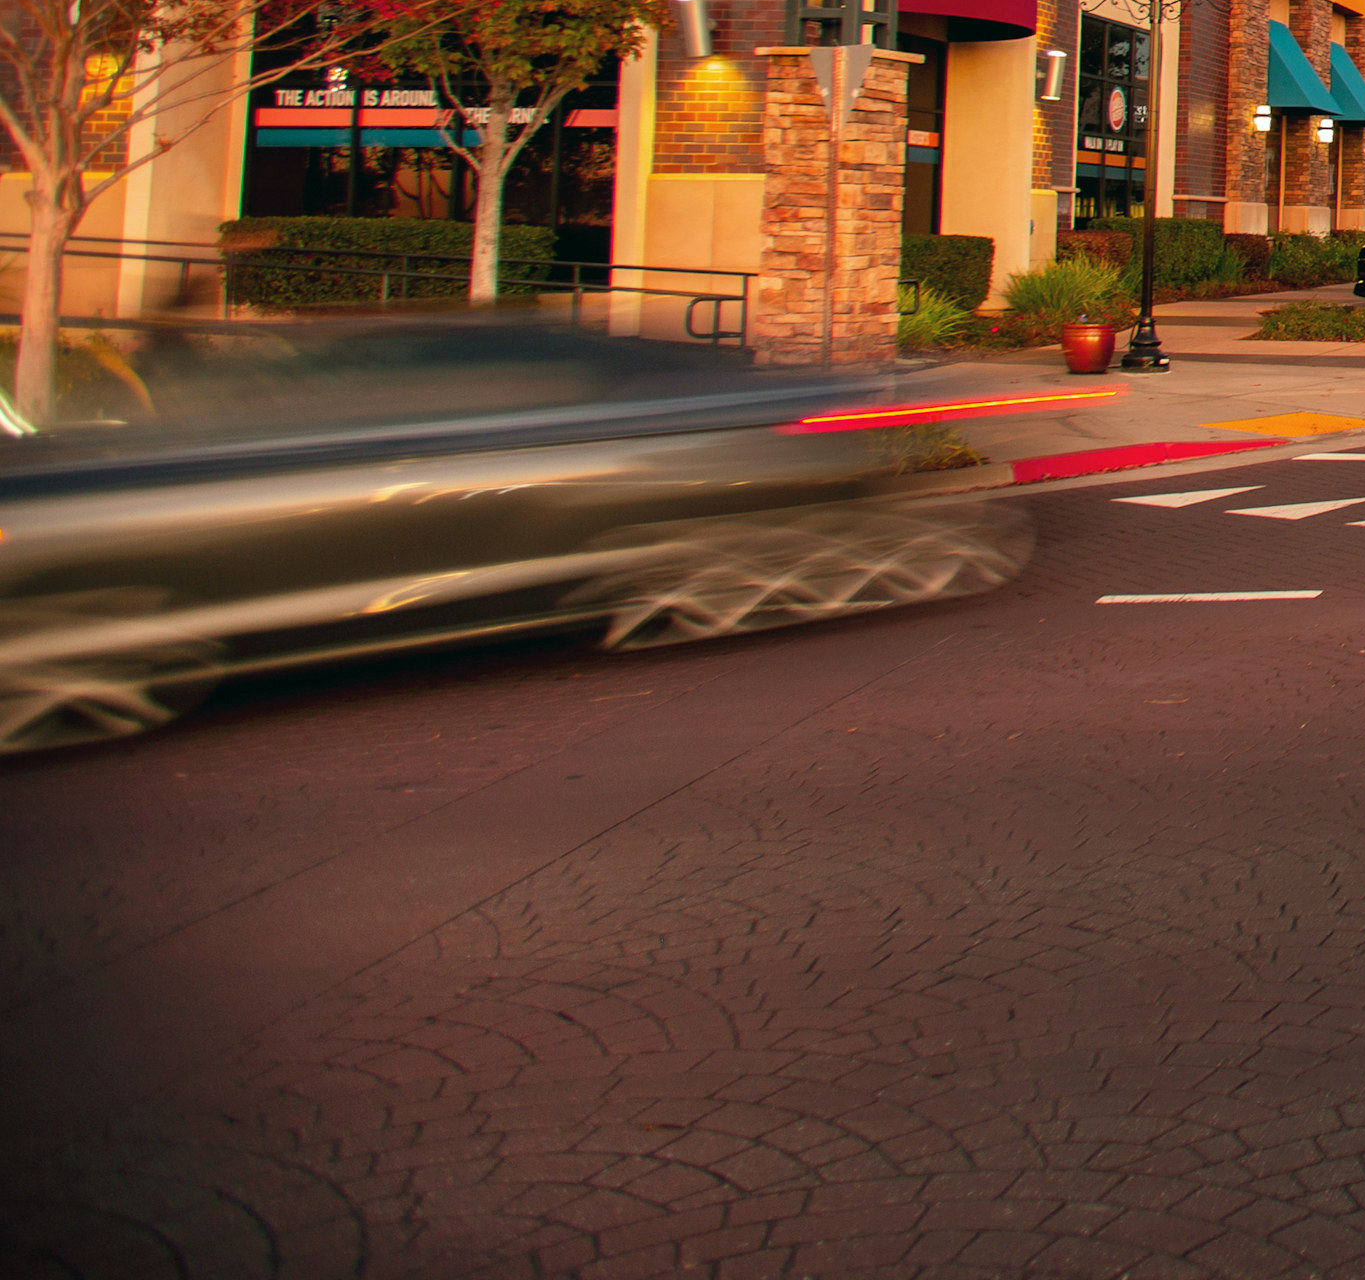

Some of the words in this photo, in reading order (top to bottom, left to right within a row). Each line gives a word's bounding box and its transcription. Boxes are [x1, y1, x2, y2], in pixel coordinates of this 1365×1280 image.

[276, 90, 303, 107] THE
[304, 90, 355, 107] ACTION
[364, 90, 379, 107] IS
[465, 107, 490, 124] THE
